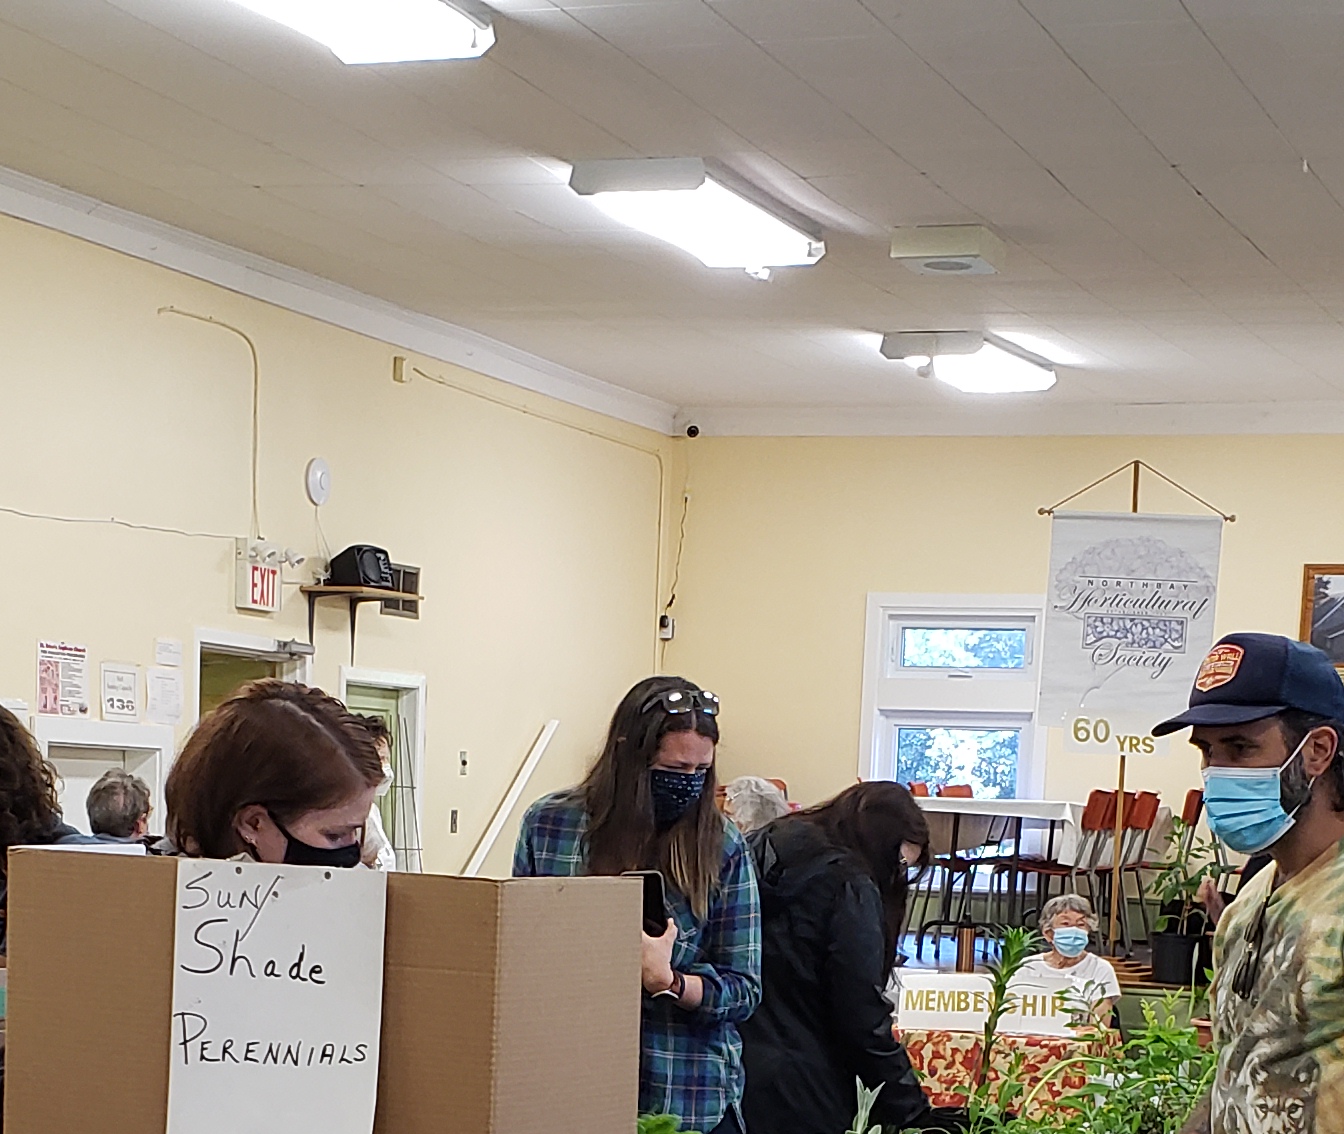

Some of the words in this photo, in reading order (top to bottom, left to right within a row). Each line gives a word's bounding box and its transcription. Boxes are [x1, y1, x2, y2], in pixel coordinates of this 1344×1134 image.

[251, 565, 277, 608] EXIT
[1054, 585, 1209, 620] Horticultural
[1091, 643, 1174, 679] Society
[1073, 717, 1111, 743] 60
[1116, 735, 1155, 754] YRS
[180, 918, 326, 984] Shade
[172, 1010, 369, 1067] PERENNIALS
